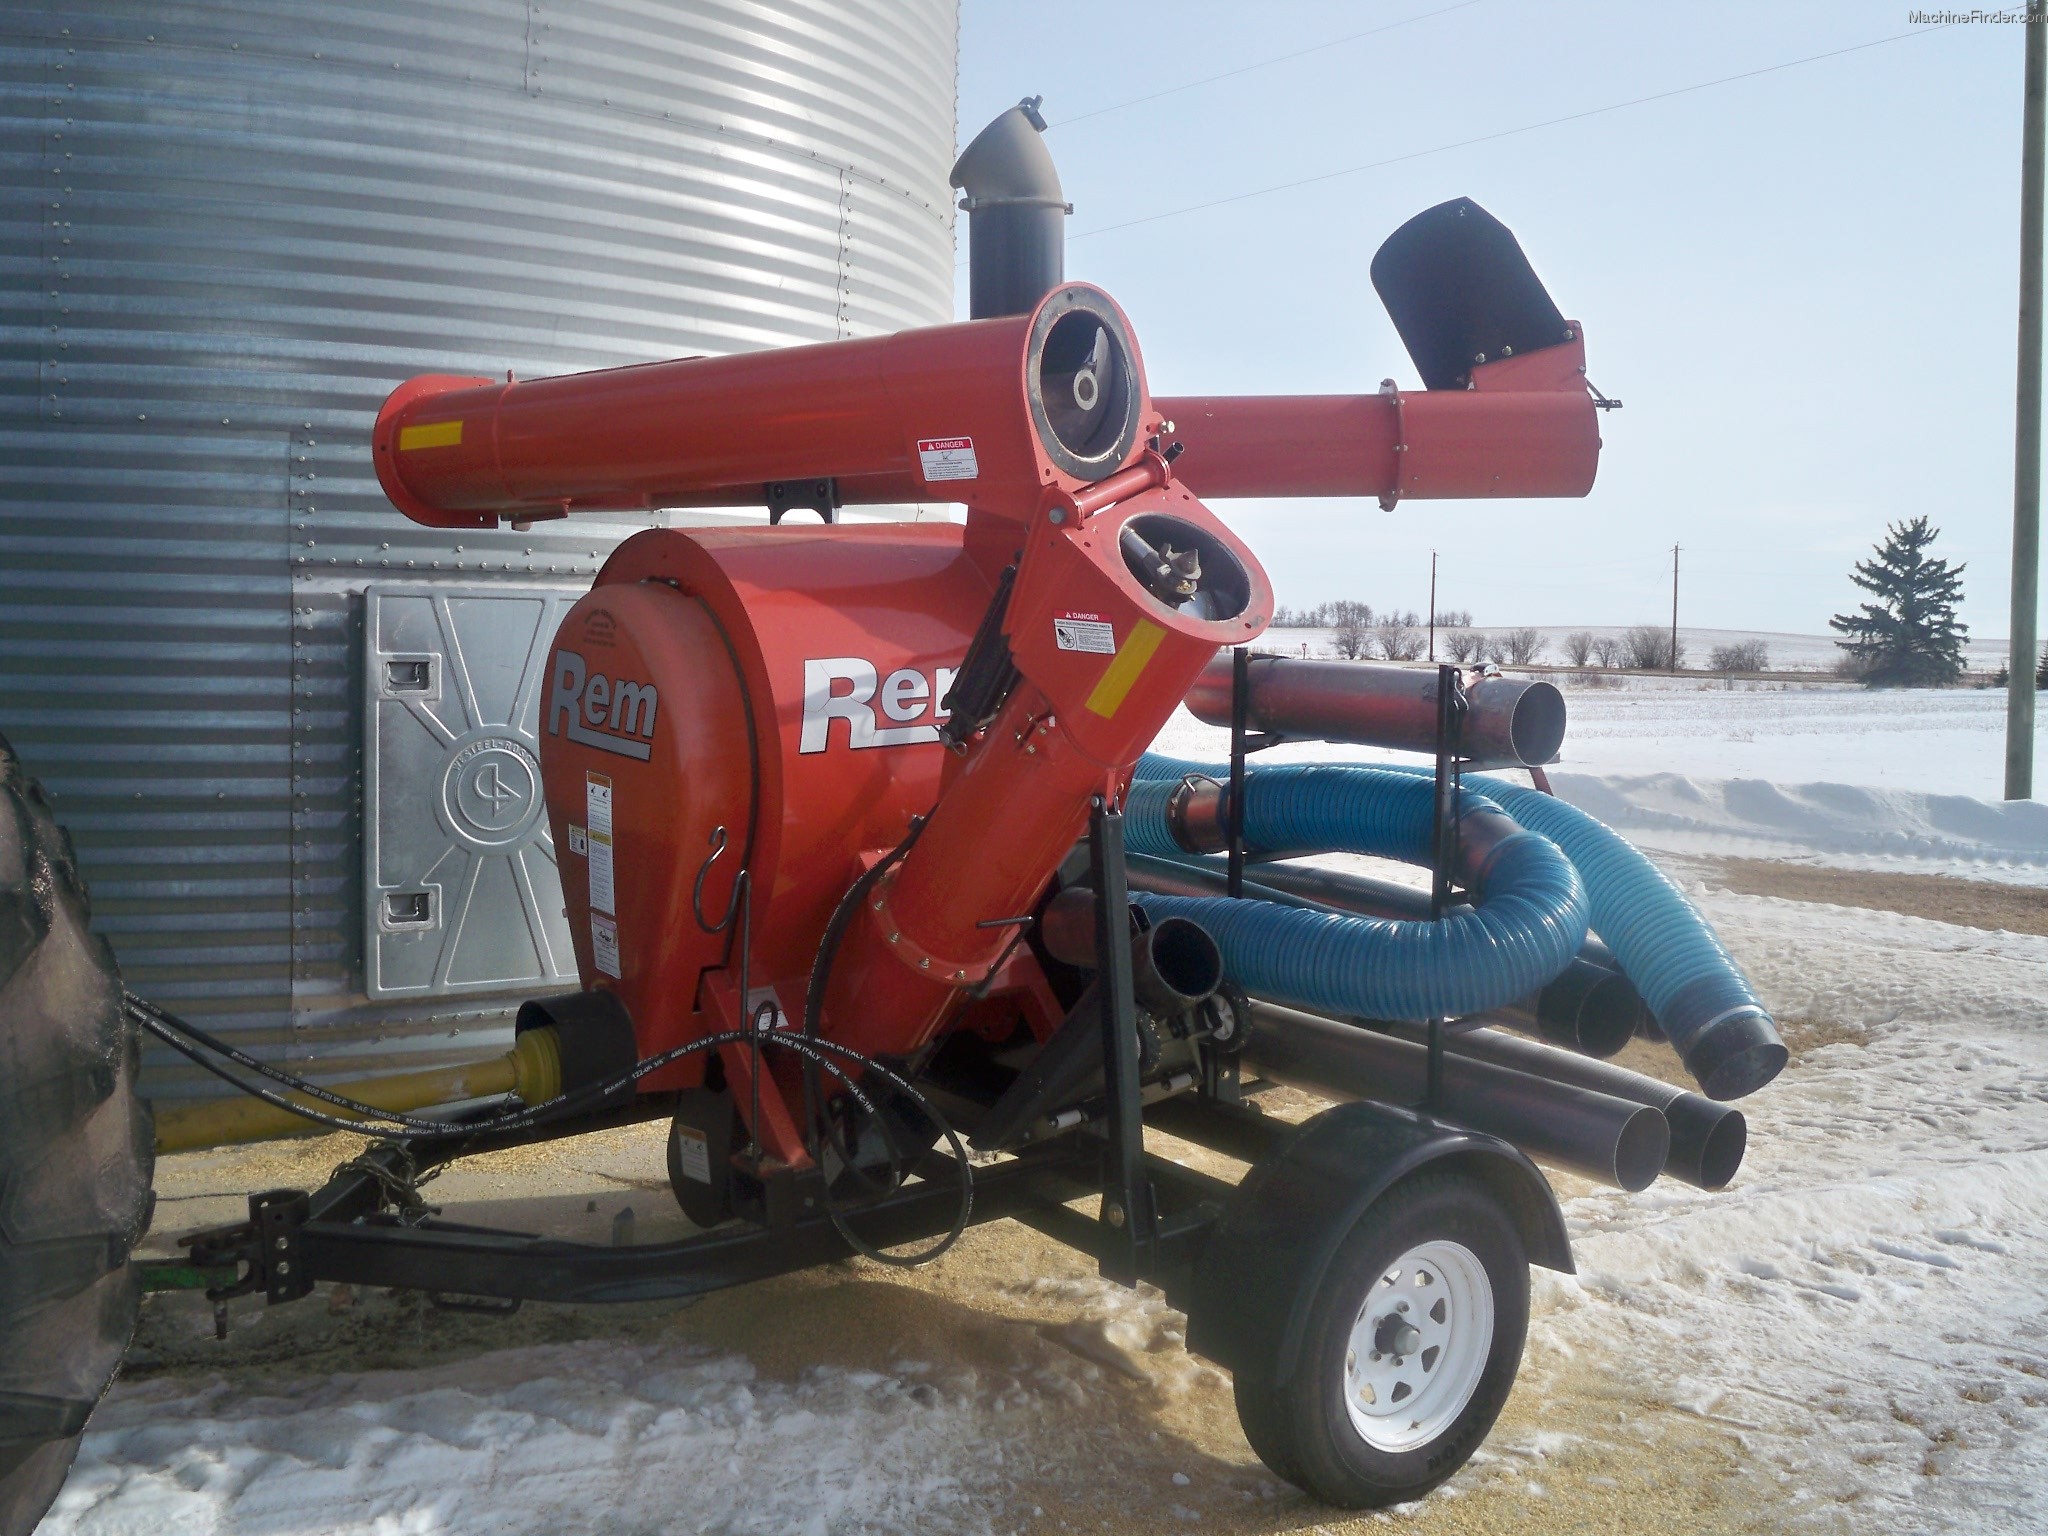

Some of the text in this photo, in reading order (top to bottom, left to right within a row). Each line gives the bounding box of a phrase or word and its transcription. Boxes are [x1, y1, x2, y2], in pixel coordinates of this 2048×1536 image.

[935, 440, 964, 449] DANGER
[1072, 612, 1099, 621] DANGER
[548, 648, 659, 762] Rem
[670, 1047, 687, 1059] 4800
[687, 1042, 700, 1052] PSI
[771, 1034, 794, 1047] MADE
[794, 1042, 802, 1051] IN
[802, 1046, 821, 1061] ITALY
[814, 1037, 836, 1049] MADE
[836, 1044, 845, 1052] IN
[845, 1048, 865, 1060] ITALY
[353, 1103, 368, 1113] SAE
[406, 1117, 428, 1127] MADE
